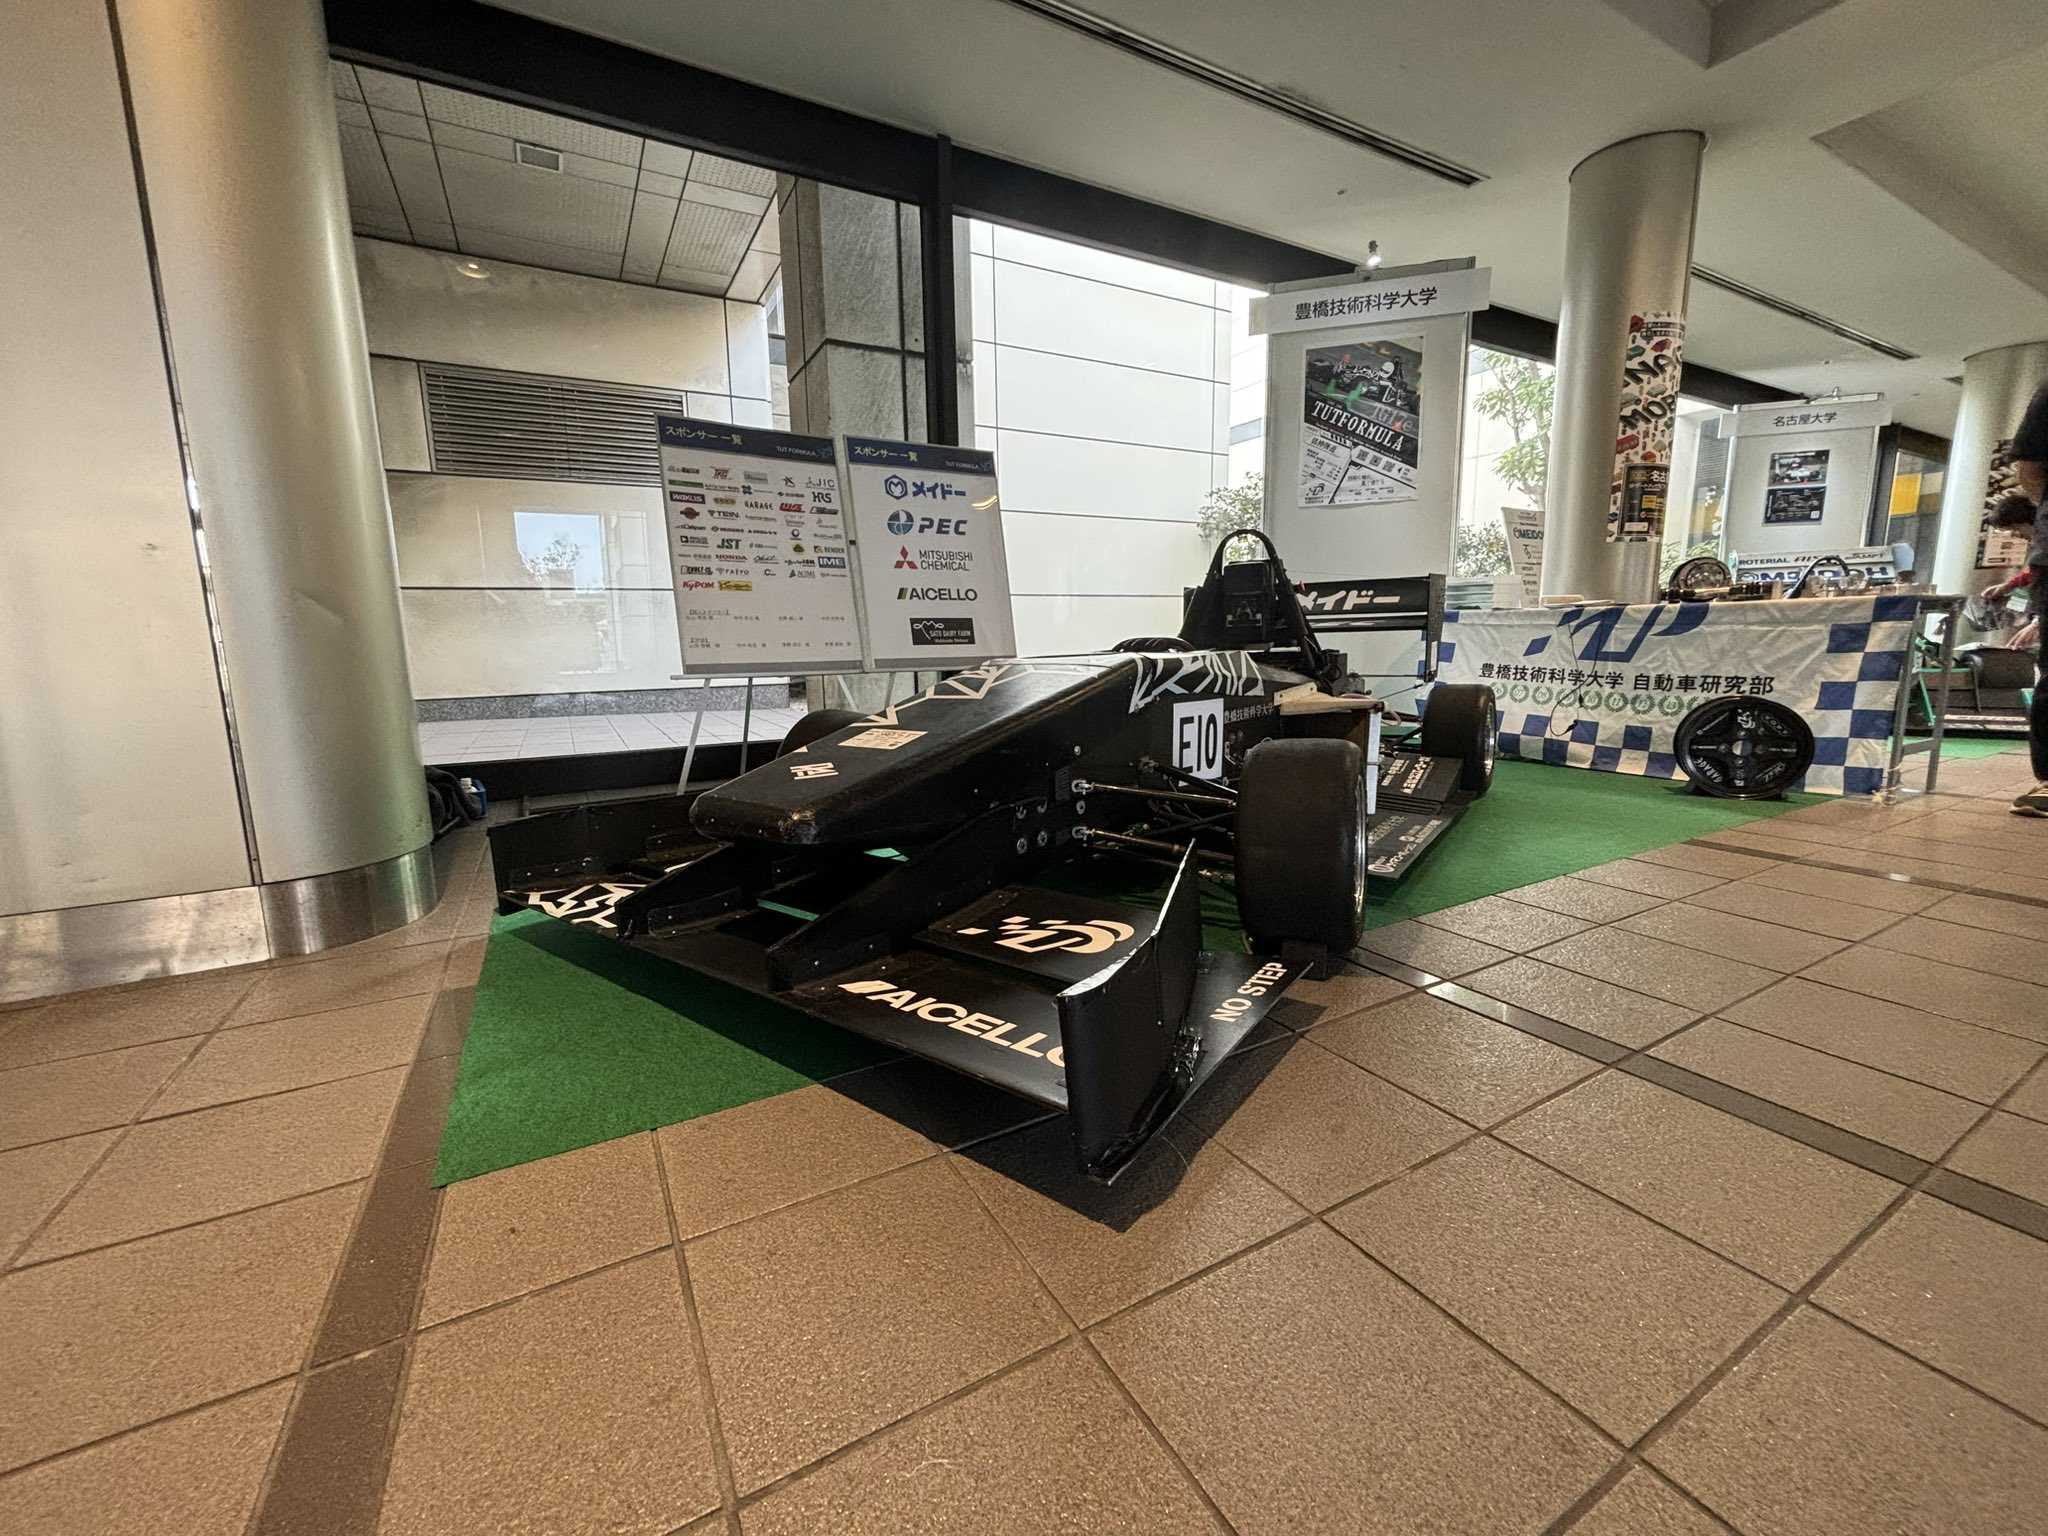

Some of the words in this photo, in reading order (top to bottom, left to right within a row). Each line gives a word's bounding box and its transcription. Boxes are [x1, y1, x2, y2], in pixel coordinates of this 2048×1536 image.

[1311, 400, 1405, 451] TUTFORMULA
[1772, 411, 1838, 427] 名古屋大学
[912, 481, 966, 500] メイドー
[918, 517, 968, 535] PEC
[717, 538, 742, 550] JST
[919, 550, 974, 561] MITSUBISHI
[1739, 557, 1790, 565] ROTERIAL
[920, 560, 970, 571] CHEMICAL
[909, 588, 978, 601] AICELLO
[1479, 662, 1624, 689] 豊橋技術科学大学
[1633, 673, 1776, 695] 自動車研究部
[1179, 713, 1217, 773] E10
[1209, 998, 1252, 1022] NO
[1237, 962, 1288, 996] STEP
